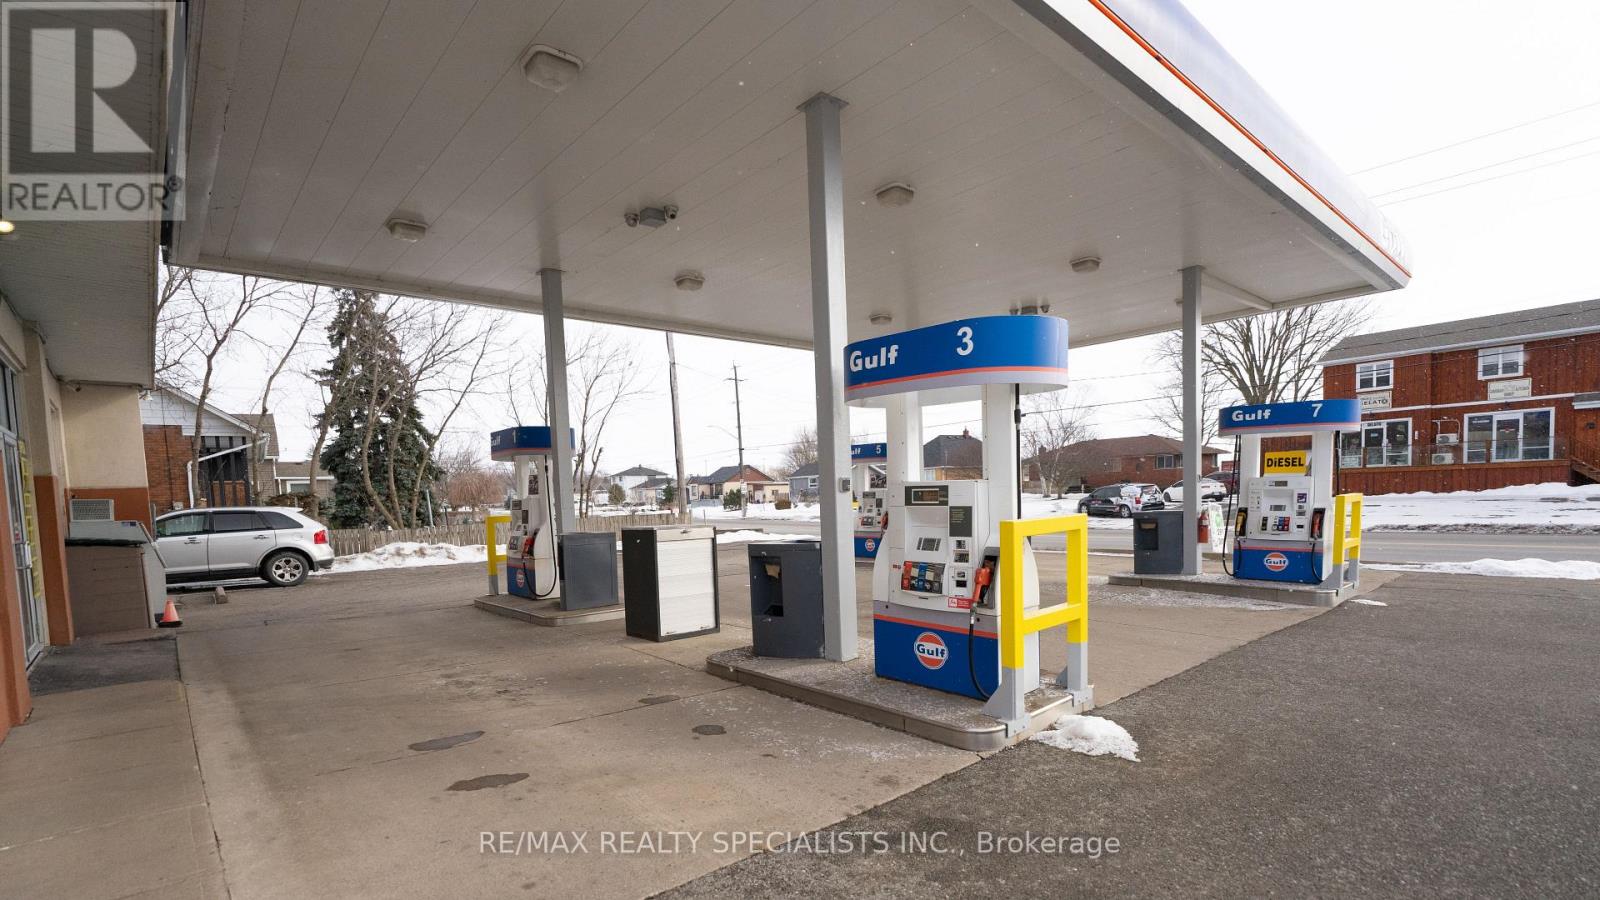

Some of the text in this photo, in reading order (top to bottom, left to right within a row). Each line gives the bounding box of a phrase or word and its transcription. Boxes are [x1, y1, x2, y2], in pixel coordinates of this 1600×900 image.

[849, 326, 974, 372] Gulf 3
[1231, 403, 1323, 422] Gulf 7
[511, 429, 516, 444] 1
[875, 444, 882, 455] 5
[916, 643, 946, 658] Gulf
